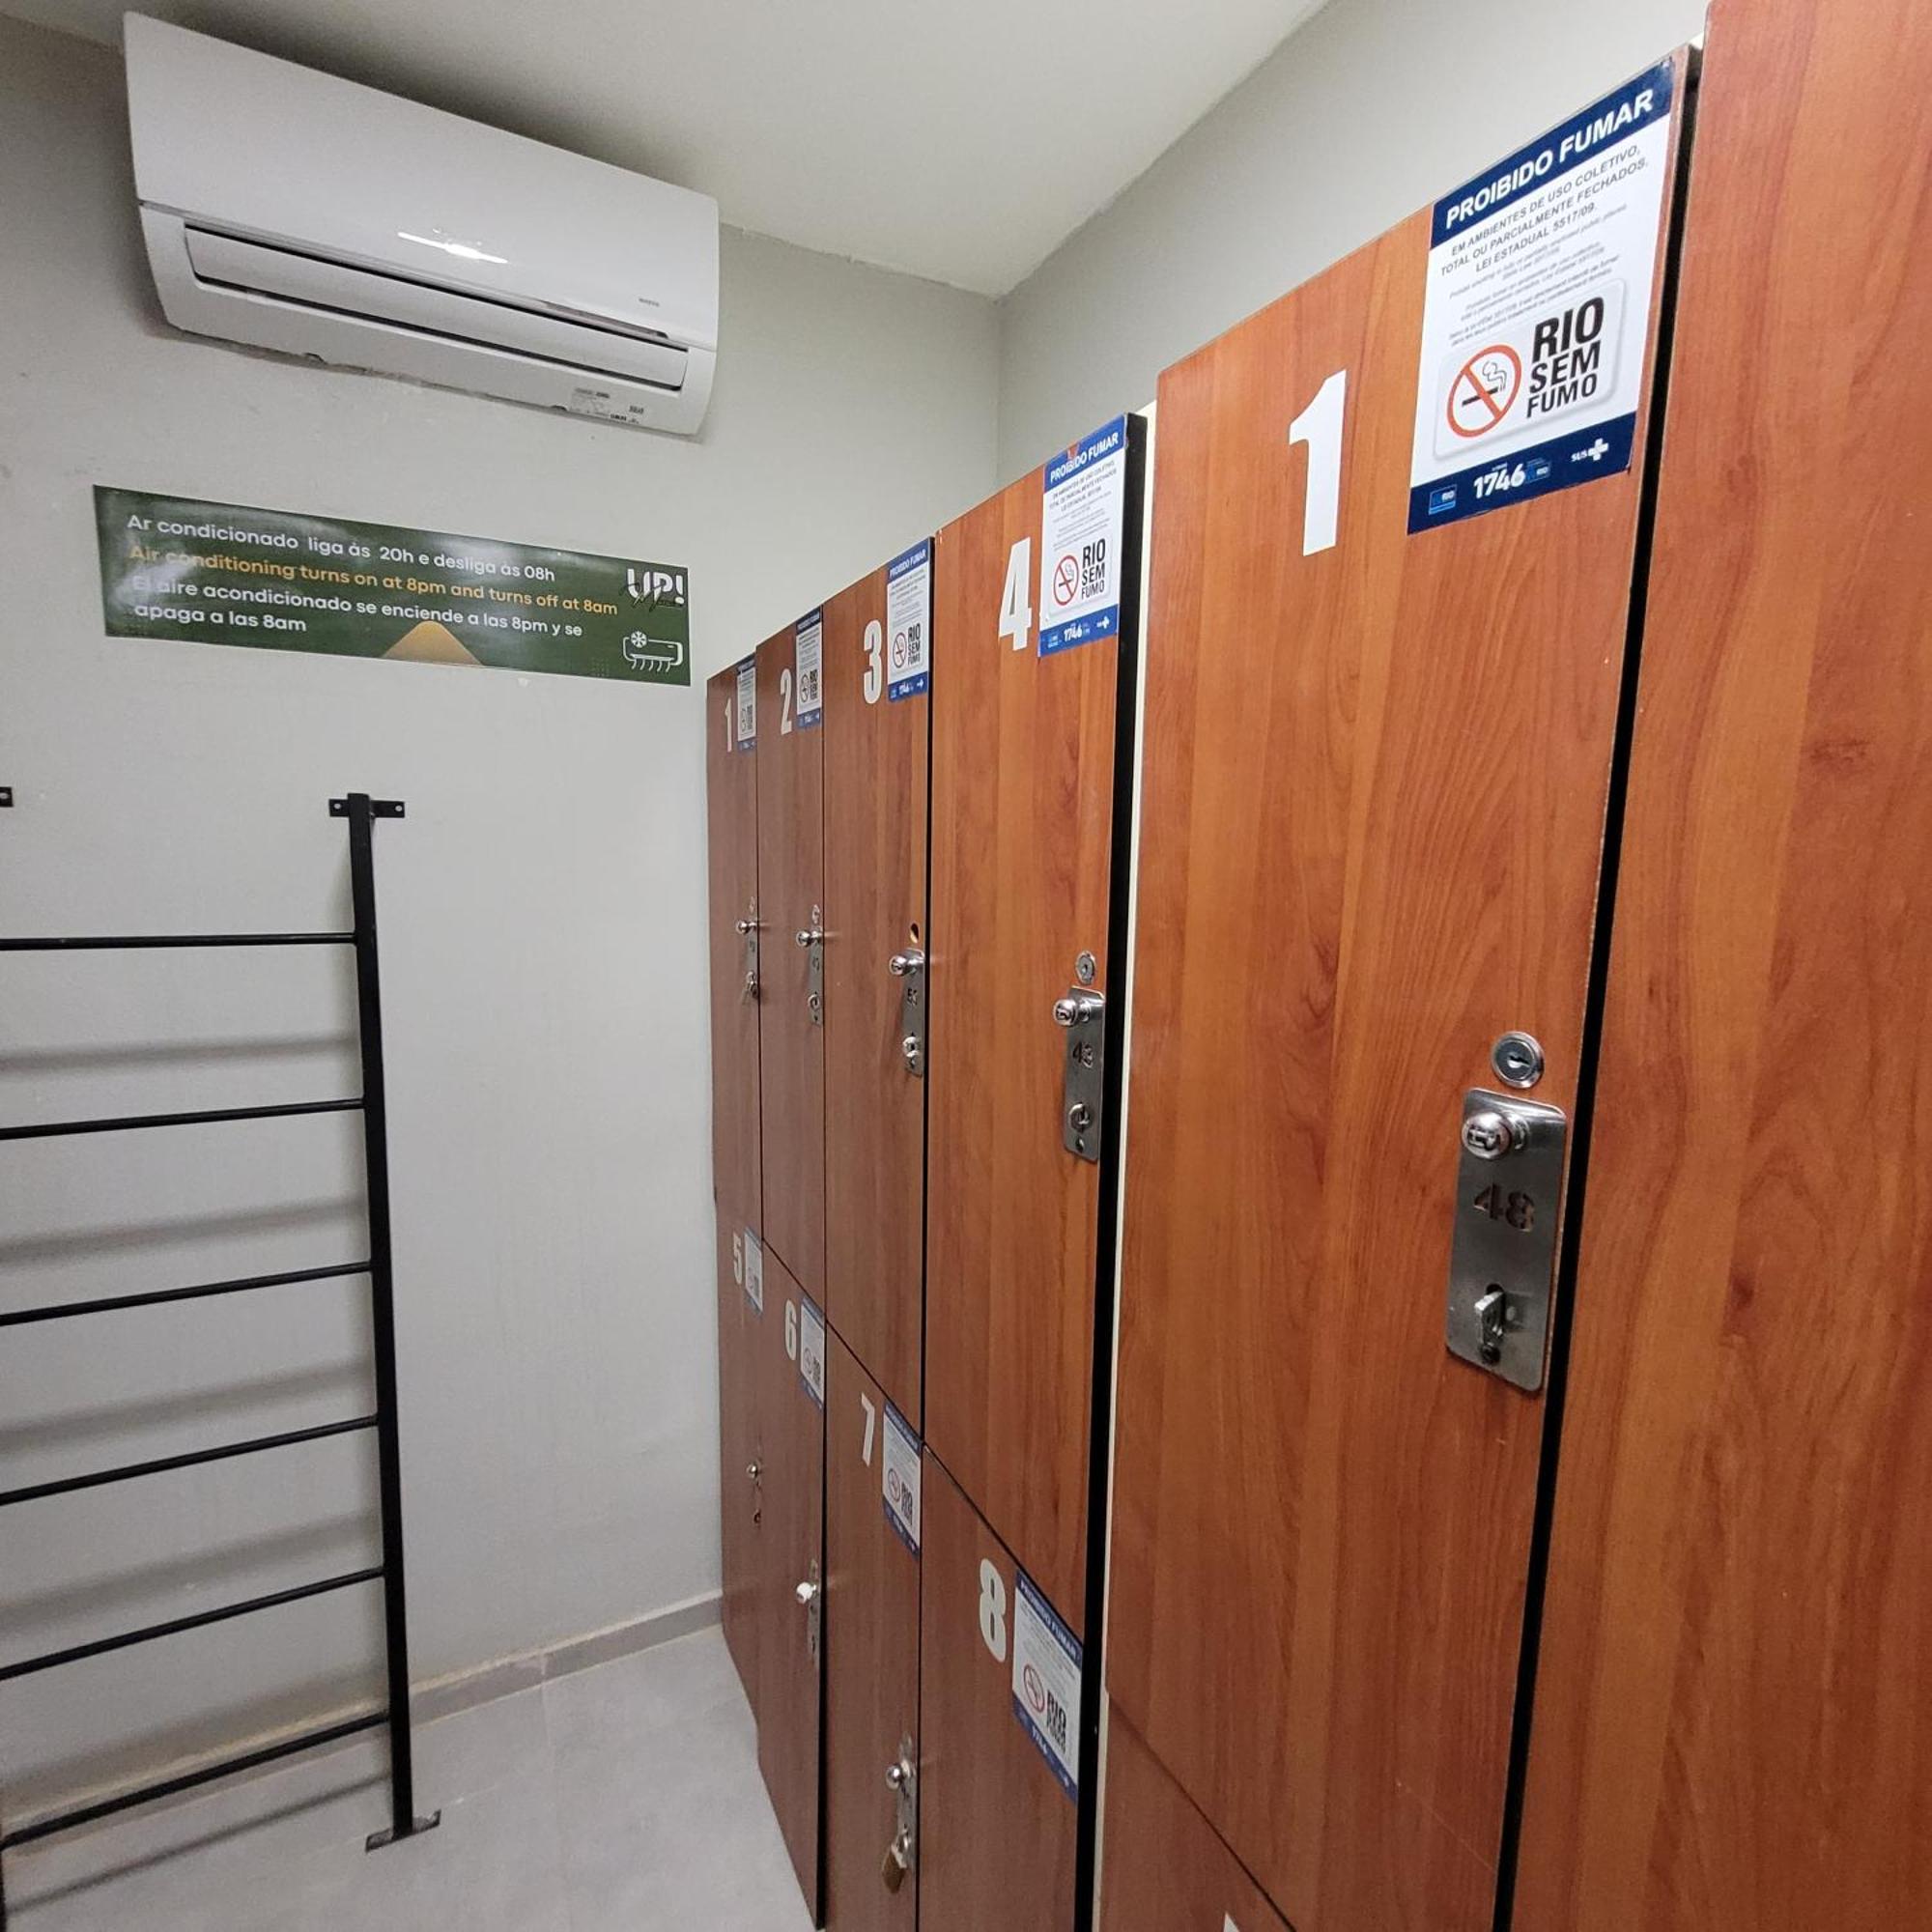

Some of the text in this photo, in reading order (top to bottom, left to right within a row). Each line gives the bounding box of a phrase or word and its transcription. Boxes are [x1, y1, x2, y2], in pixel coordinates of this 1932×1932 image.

[1445, 89, 1654, 229] PROIBIDO FUMAR
[1440, 255, 1470, 277] TOTAL
[1472, 244, 1489, 259] OU
[1490, 199, 1574, 250] PARCIALMENTE
[1451, 242, 1467, 257] EM
[1468, 206, 1527, 247] AMBIENTES
[1529, 199, 1545, 213] DE
[1548, 183, 1573, 202] USO
[1475, 258, 1492, 273] LEI
[1493, 229, 1549, 264] ESTADUAL
[1531, 297, 1605, 364] RIO
[1526, 373, 1598, 419] FUMO
[1529, 340, 1601, 395] SEM
[1088, 432, 1119, 462] FUMAR
[1289, 369, 1347, 556] 1
[1473, 463, 1526, 499] 1746
[127, 515, 152, 530] Ar
[156, 521, 298, 550] condicionado
[308, 536, 344, 555] liga
[380, 546, 414, 563] 20h
[418, 554, 430, 565] e
[434, 554, 497, 575] desliga
[525, 565, 555, 582] 08h
[1082, 538, 1106, 570] RIO
[1082, 562, 1105, 586] SEM
[129, 545, 618, 615] Air conditioning turns on at 8pm and turns off at 8am
[157, 579, 198, 596] aire
[203, 585, 353, 612] acondicionado
[356, 601, 377, 614] se
[382, 604, 464, 623] enciende
[468, 613, 479, 625] a
[483, 612, 508, 629] las
[511, 615, 548, 633] 8pm
[552, 623, 561, 637] y
[565, 624, 582, 637] se
[627, 568, 685, 605] UP!
[999, 537, 1033, 652] 4
[1081, 580, 1105, 600] FUMO
[134, 605, 307, 632] apaga a las 8am
[864, 619, 882, 704] 3
[724, 697, 732, 753] 1
[780, 668, 792, 735] 2
[1473, 1182, 1536, 1233] 48
[732, 1231, 743, 1286] 5
[784, 1298, 797, 1361] 6
[861, 1392, 875, 1467] 7
[980, 1557, 1007, 1663] 8
